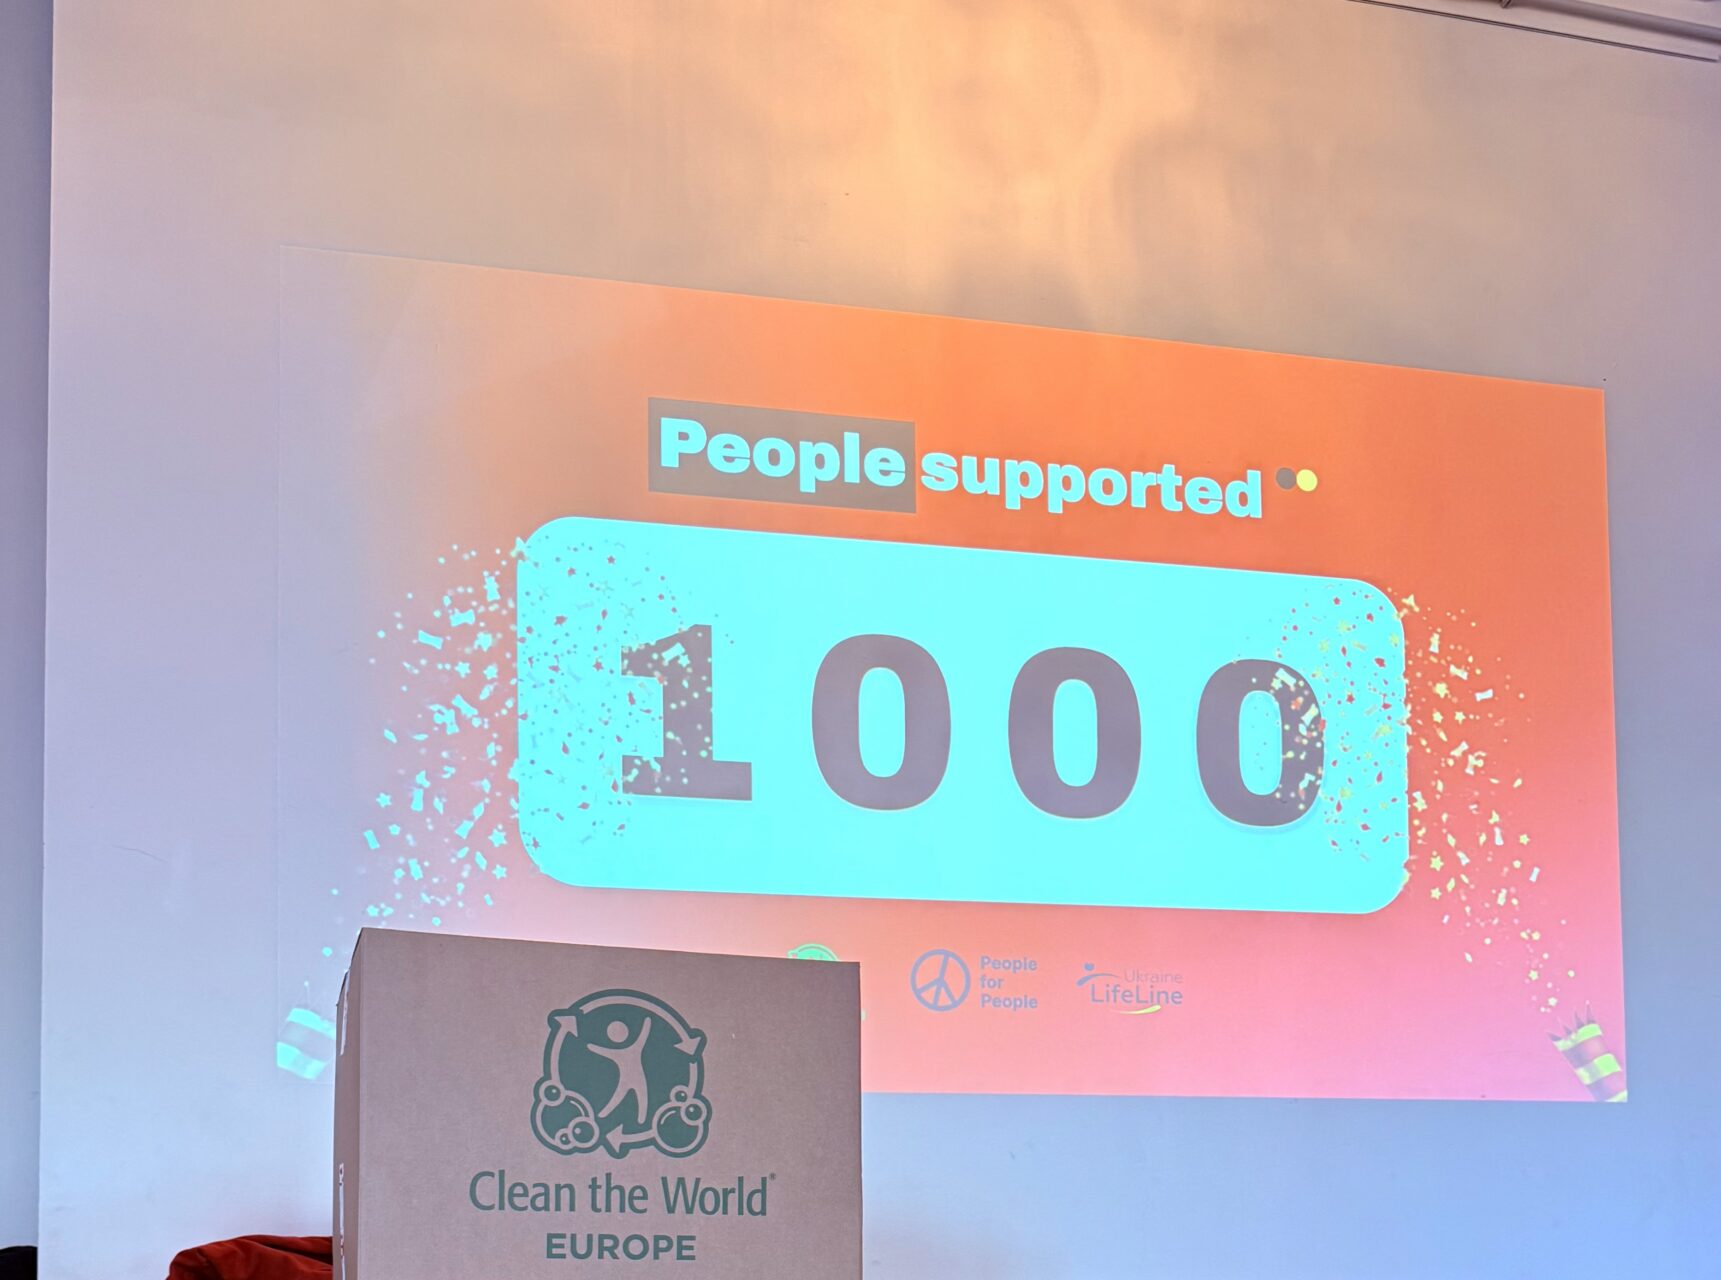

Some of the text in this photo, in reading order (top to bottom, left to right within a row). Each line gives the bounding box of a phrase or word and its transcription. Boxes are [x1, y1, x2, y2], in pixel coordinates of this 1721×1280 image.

[661, 416, 1262, 518] People supported
[980, 955, 1038, 973] People
[980, 974, 1005, 989] for
[1124, 969, 1184, 984] Ukraine
[981, 993, 1039, 1011] People
[1090, 983, 1184, 1006] LifeLine
[468, 1168, 576, 1214] Clean
[588, 1173, 648, 1214] the
[544, 1232, 697, 1262] EUROPE
